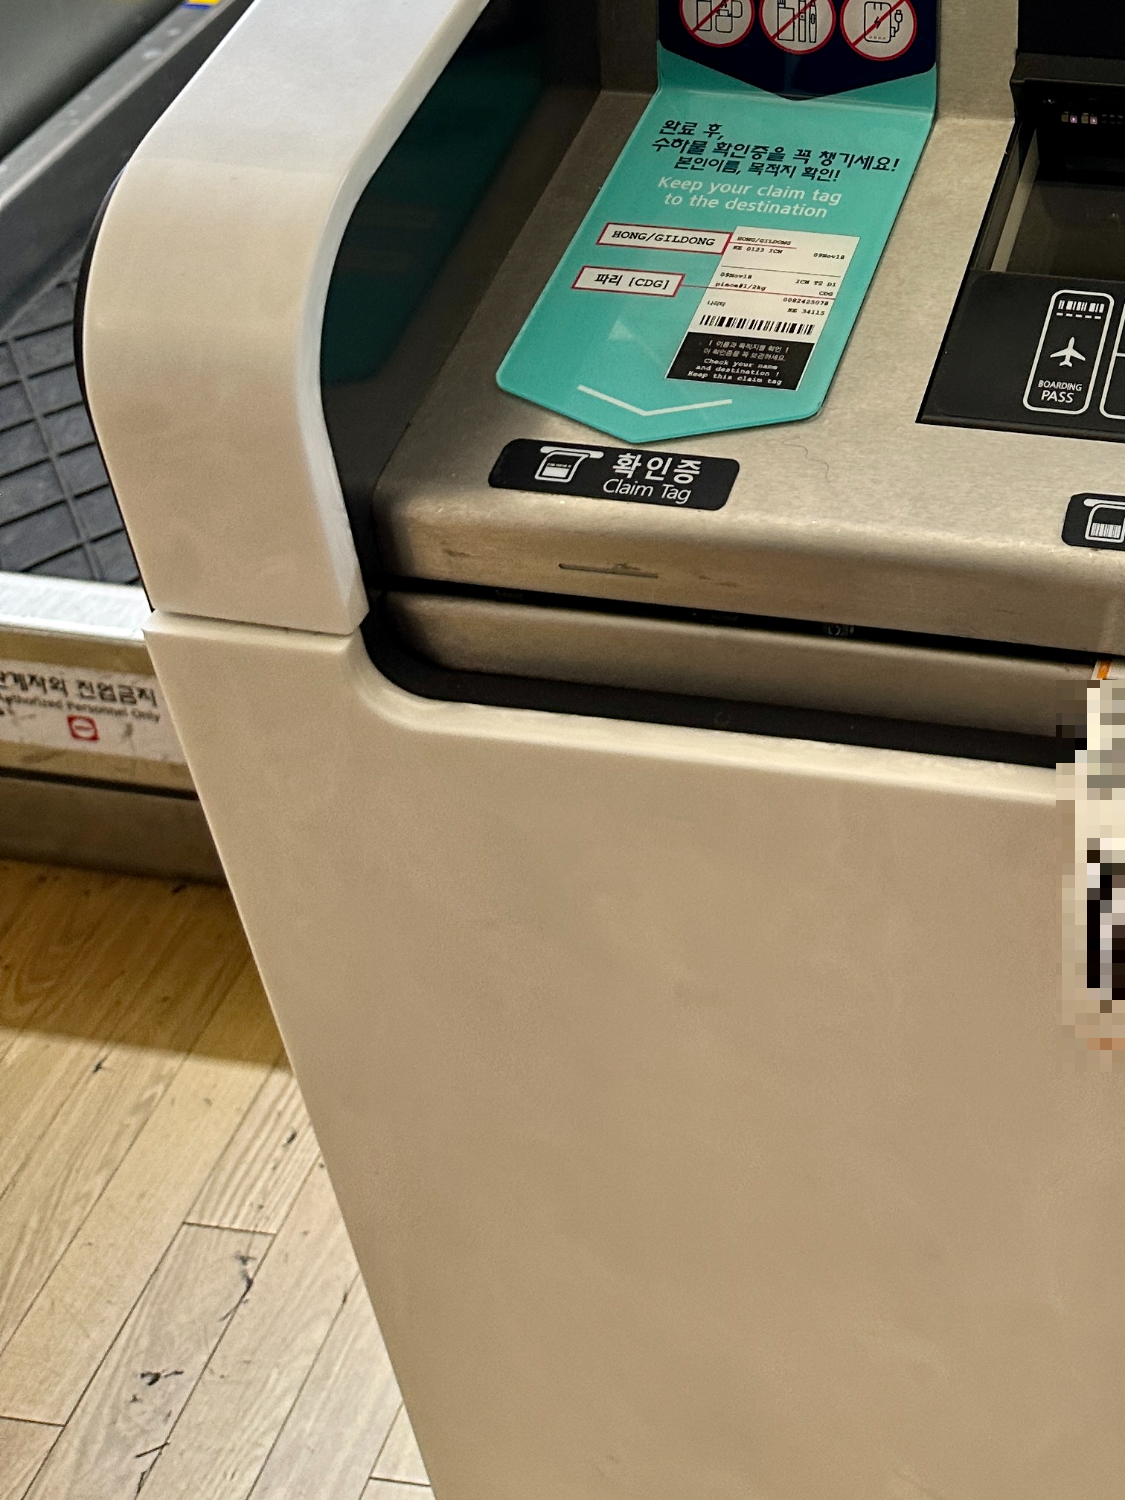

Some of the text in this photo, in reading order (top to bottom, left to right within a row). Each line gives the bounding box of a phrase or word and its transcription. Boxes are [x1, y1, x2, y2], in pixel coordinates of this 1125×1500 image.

[659, 119, 725, 140] 완료 후,
[651, 137, 901, 173] 수하물 확인증을 꼭 챙기세요!
[674, 156, 841, 183] 본인이름, 목적지 확인!
[658, 176, 842, 207] Keep your claim tag
[664, 192, 828, 219] to the destination
[611, 230, 716, 247] HONG/GILDONG
[736, 236, 792, 246] HONG/GILDONG
[594, 273, 670, 290] 파리 [CDG]
[695, 364, 712, 372] and
[715, 366, 770, 377] destination
[703, 357, 729, 366] Check
[733, 360, 754, 369] your
[687, 370, 709, 379] Keep
[737, 375, 763, 383] claim
[767, 377, 783, 386] tag
[1037, 379, 1083, 393] BOARDING
[1041, 390, 1075, 404] PASS
[612, 452, 702, 485] 확인증
[602, 478, 692, 505] Claim Tag
